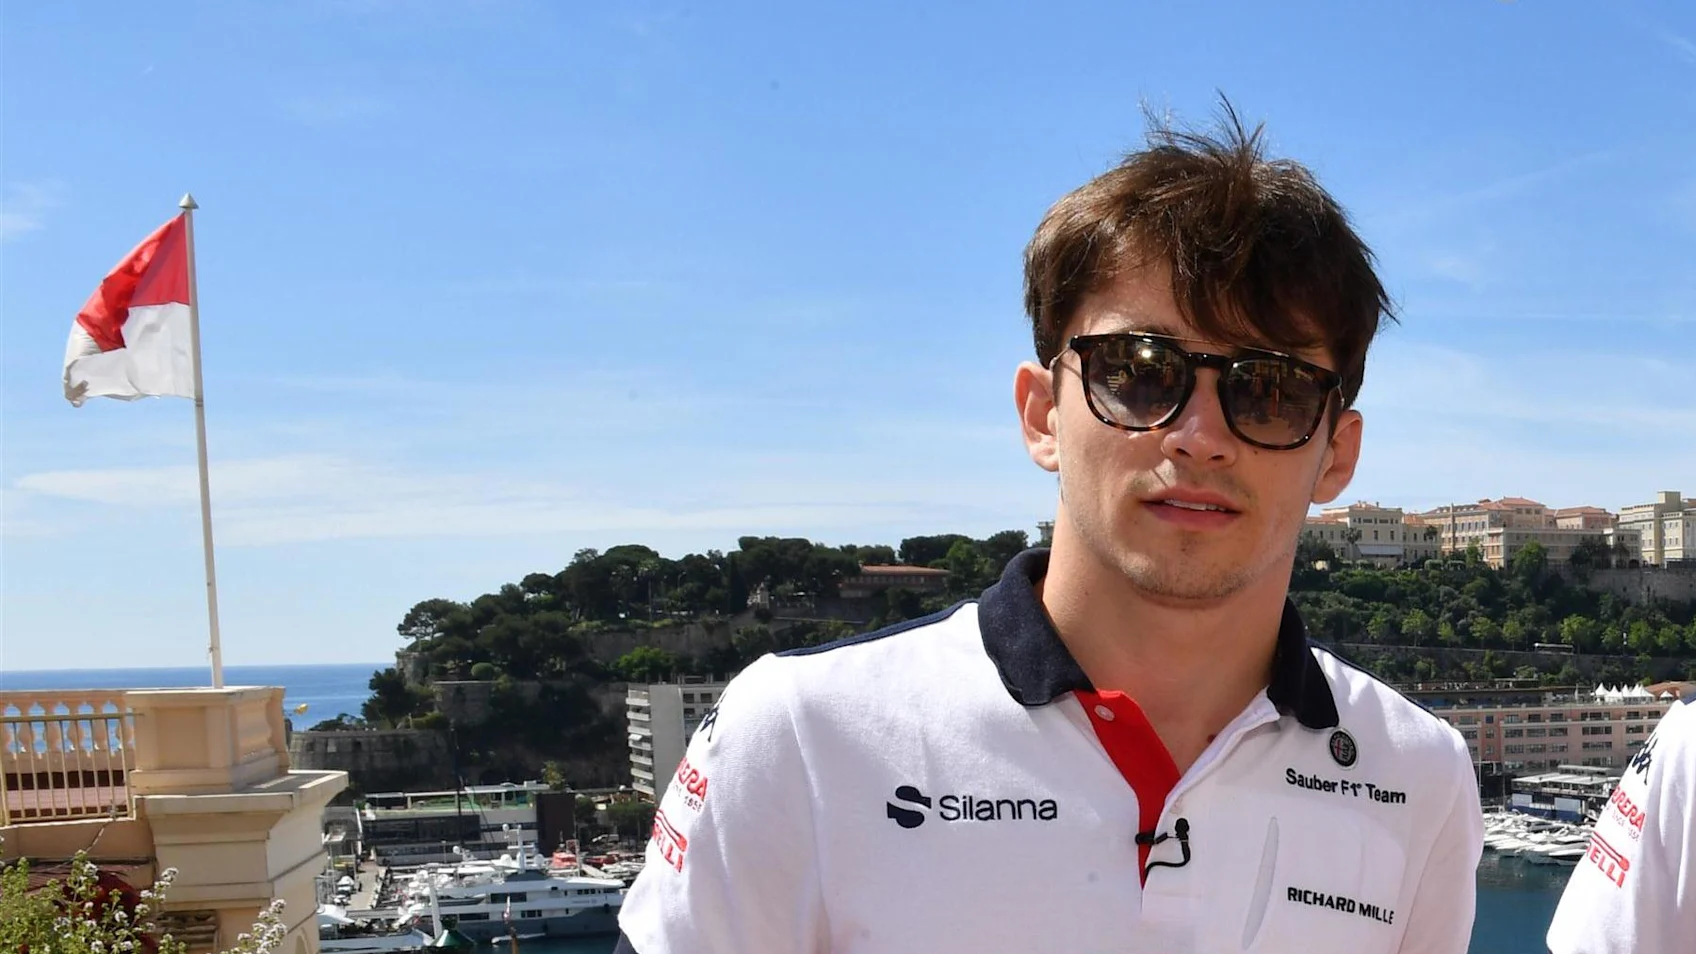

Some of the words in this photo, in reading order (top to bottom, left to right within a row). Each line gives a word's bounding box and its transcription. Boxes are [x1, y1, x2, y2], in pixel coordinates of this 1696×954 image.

[1286, 767, 1338, 794] Sauber
[1365, 783, 1407, 804] Team
[939, 794, 1058, 822] Silanna
[1287, 886, 1355, 914] RICHARD
[1359, 902, 1395, 925] MILLE
